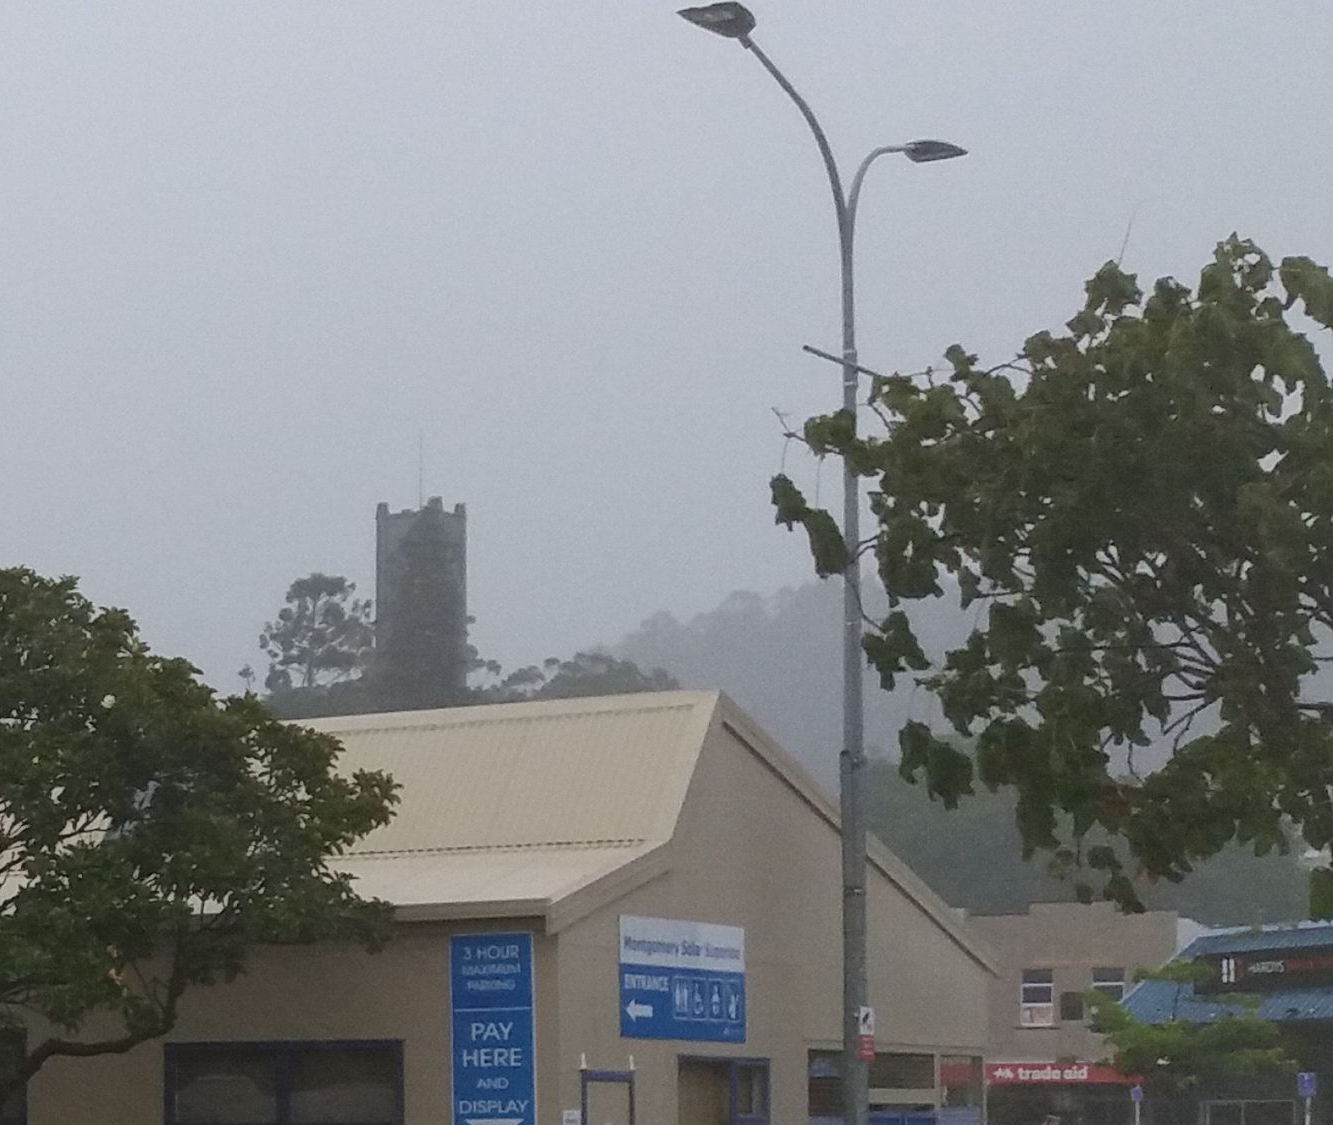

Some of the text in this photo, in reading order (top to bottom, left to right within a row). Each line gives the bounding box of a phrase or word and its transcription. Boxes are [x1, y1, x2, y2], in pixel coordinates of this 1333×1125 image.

[463, 944, 520, 960] 3 HOUR
[624, 972, 670, 992] ENTRANCE
[471, 1021, 514, 1041] PAY
[463, 1047, 522, 1068] HERE
[1018, 1065, 1088, 1080] trade aid
[476, 1077, 509, 1090] AND
[459, 1099, 530, 1115] DISPLAY
